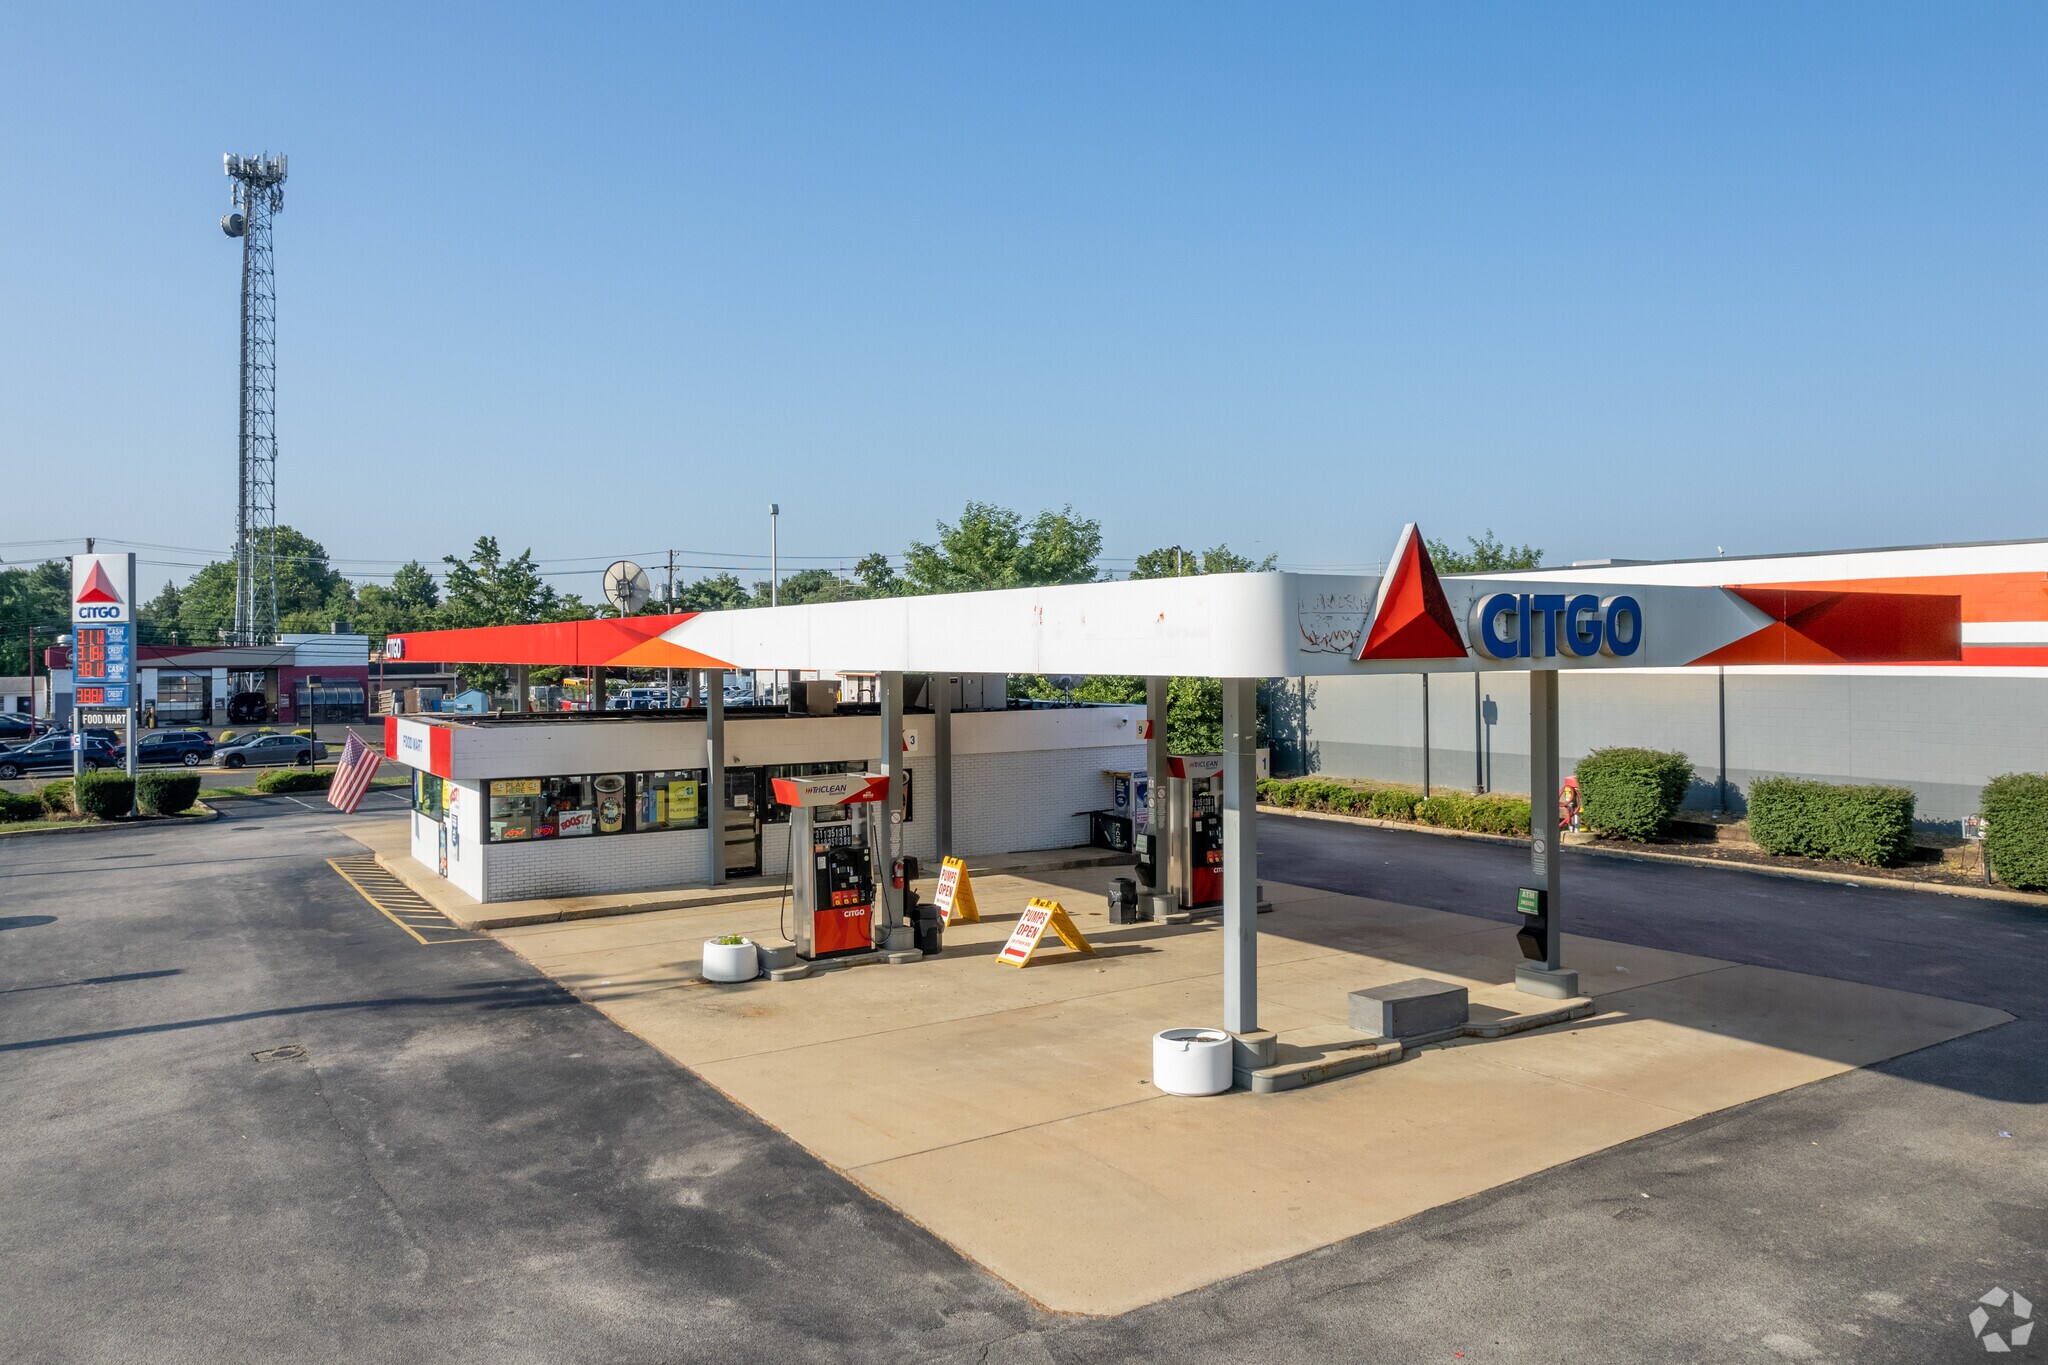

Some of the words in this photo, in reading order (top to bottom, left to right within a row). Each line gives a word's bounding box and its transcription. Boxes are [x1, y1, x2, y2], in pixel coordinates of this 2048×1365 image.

[78, 606, 120, 618] CITGO
[107, 628, 124, 636] CASH
[1480, 593, 1642, 659] CITGO
[107, 665, 124, 673] CASH
[82, 714, 103, 724] FOOD
[104, 714, 126, 724] MART
[1138, 725, 1143, 735] 9
[403, 734, 412, 749] FOOD
[412, 736, 422, 752] MART
[910, 735, 916, 745] 3
[1262, 757, 1267, 770] 1
[560, 814, 591, 830] BOOST!
[533, 828, 554, 836] OPEN
[941, 869, 957, 884] PUMPS
[938, 883, 953, 898] OPEN
[1522, 891, 1535, 900] ATM
[844, 908, 865, 918] CITGO
[1022, 909, 1048, 924] PUMPS
[1016, 924, 1040, 938] OPEN
